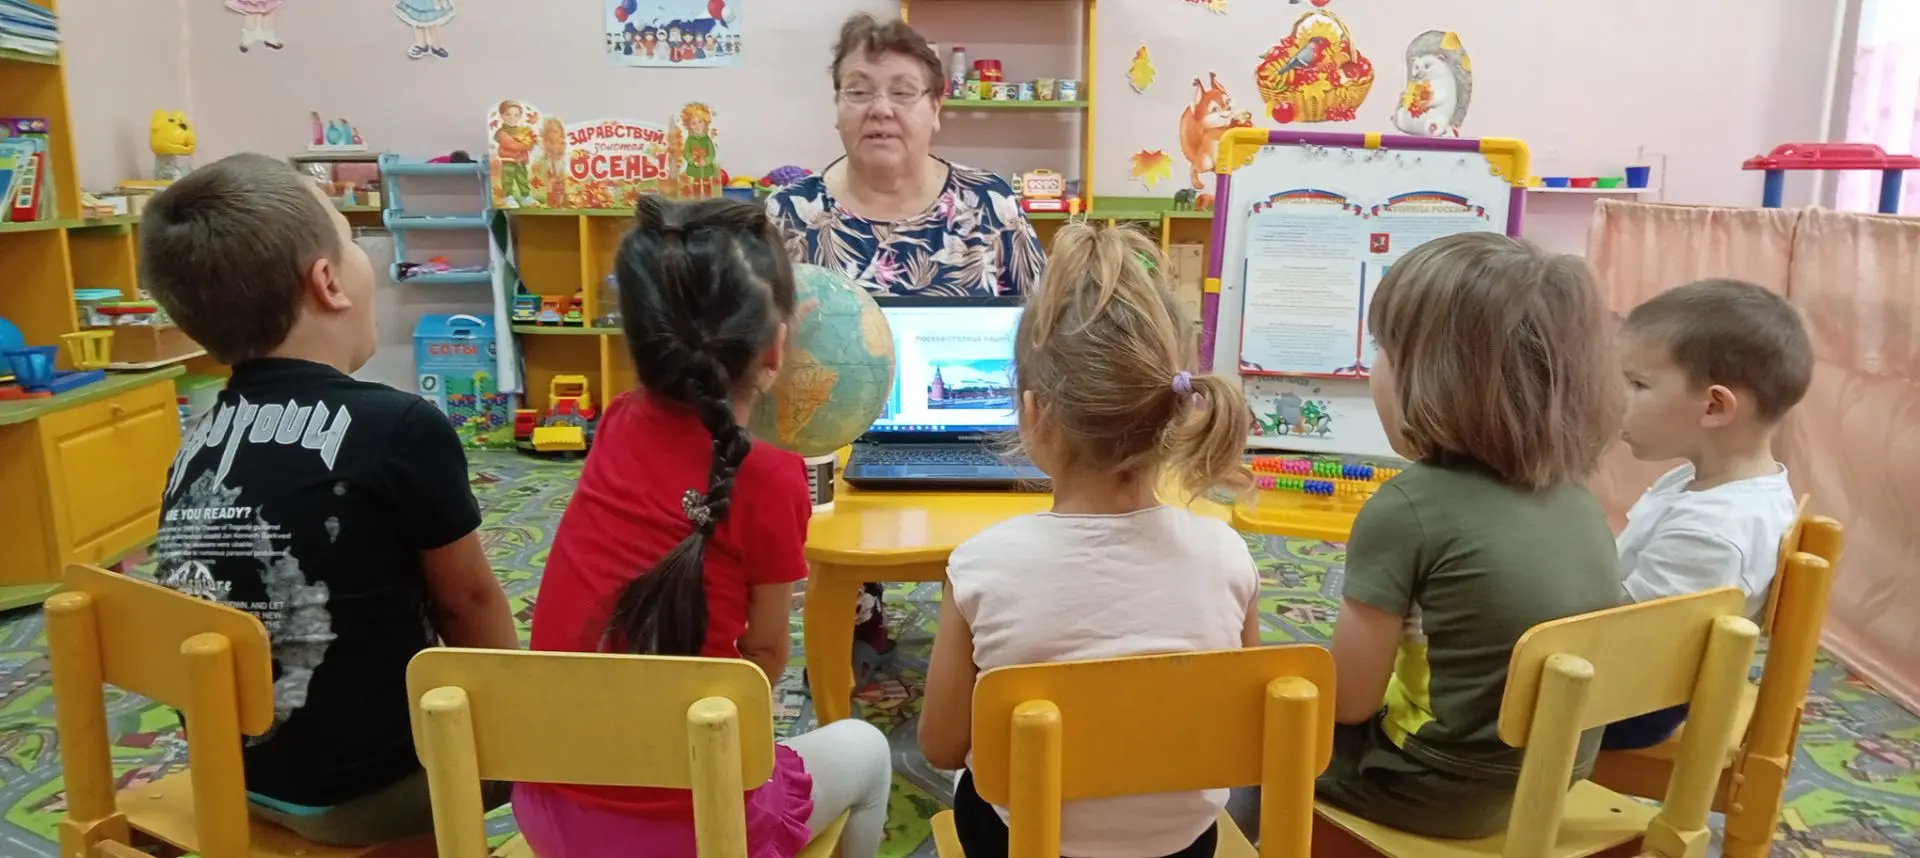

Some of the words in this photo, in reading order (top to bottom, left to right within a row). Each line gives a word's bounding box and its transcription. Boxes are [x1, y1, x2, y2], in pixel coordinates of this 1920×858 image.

[567, 125, 667, 146] ЗДРАВСТВУЙ,
[570, 152, 668, 180] ОСЕНЬ!
[429, 344, 477, 355] СОТЫ
[181, 508, 202, 520] YOU
[203, 506, 252, 520] READY?
